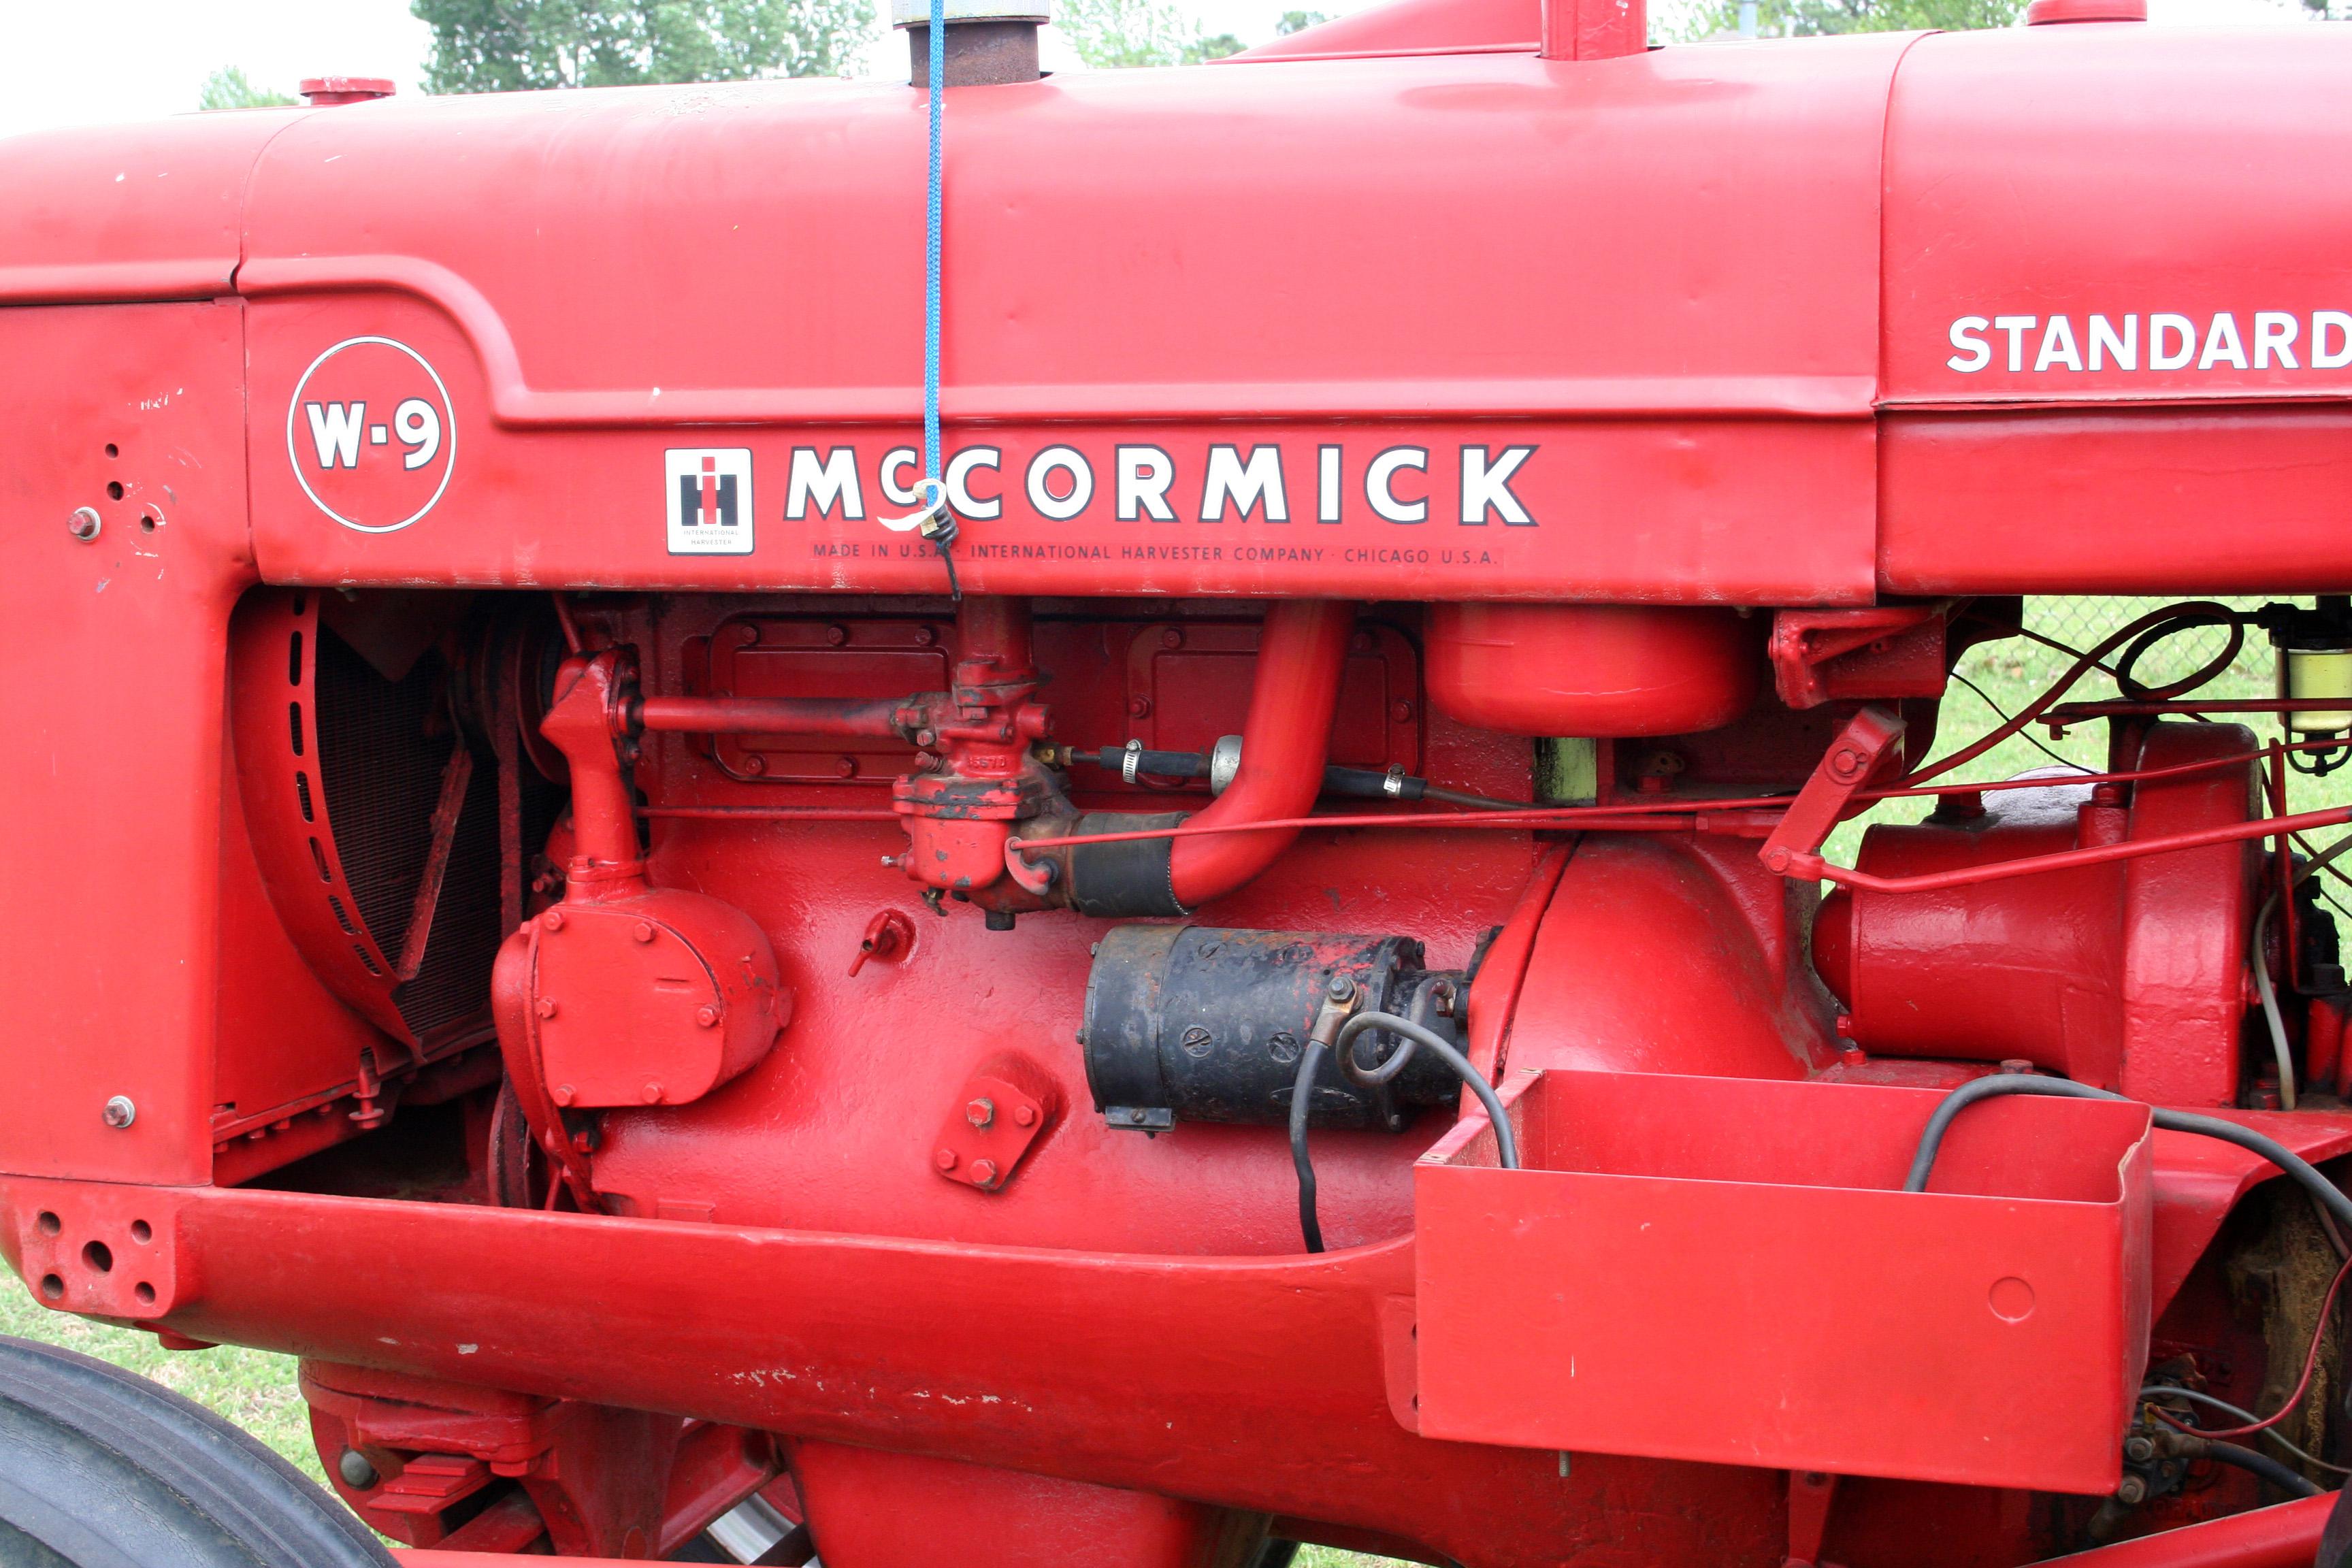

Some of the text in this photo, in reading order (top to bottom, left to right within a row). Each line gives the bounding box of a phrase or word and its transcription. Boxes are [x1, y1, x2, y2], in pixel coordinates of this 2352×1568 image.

[1946, 310, 2352, 373] STANDARD
[304, 397, 441, 470] W-9
[813, 544, 860, 557] MADE
[872, 544, 888, 557] IN
[971, 544, 1111, 559] INTERNATIONAL
[1122, 546, 1223, 559] HARVESTER
[1233, 547, 1324, 561] COMPANY
[1344, 549, 1429, 563] CHICAGO
[1441, 550, 1498, 564] U.S.A.
